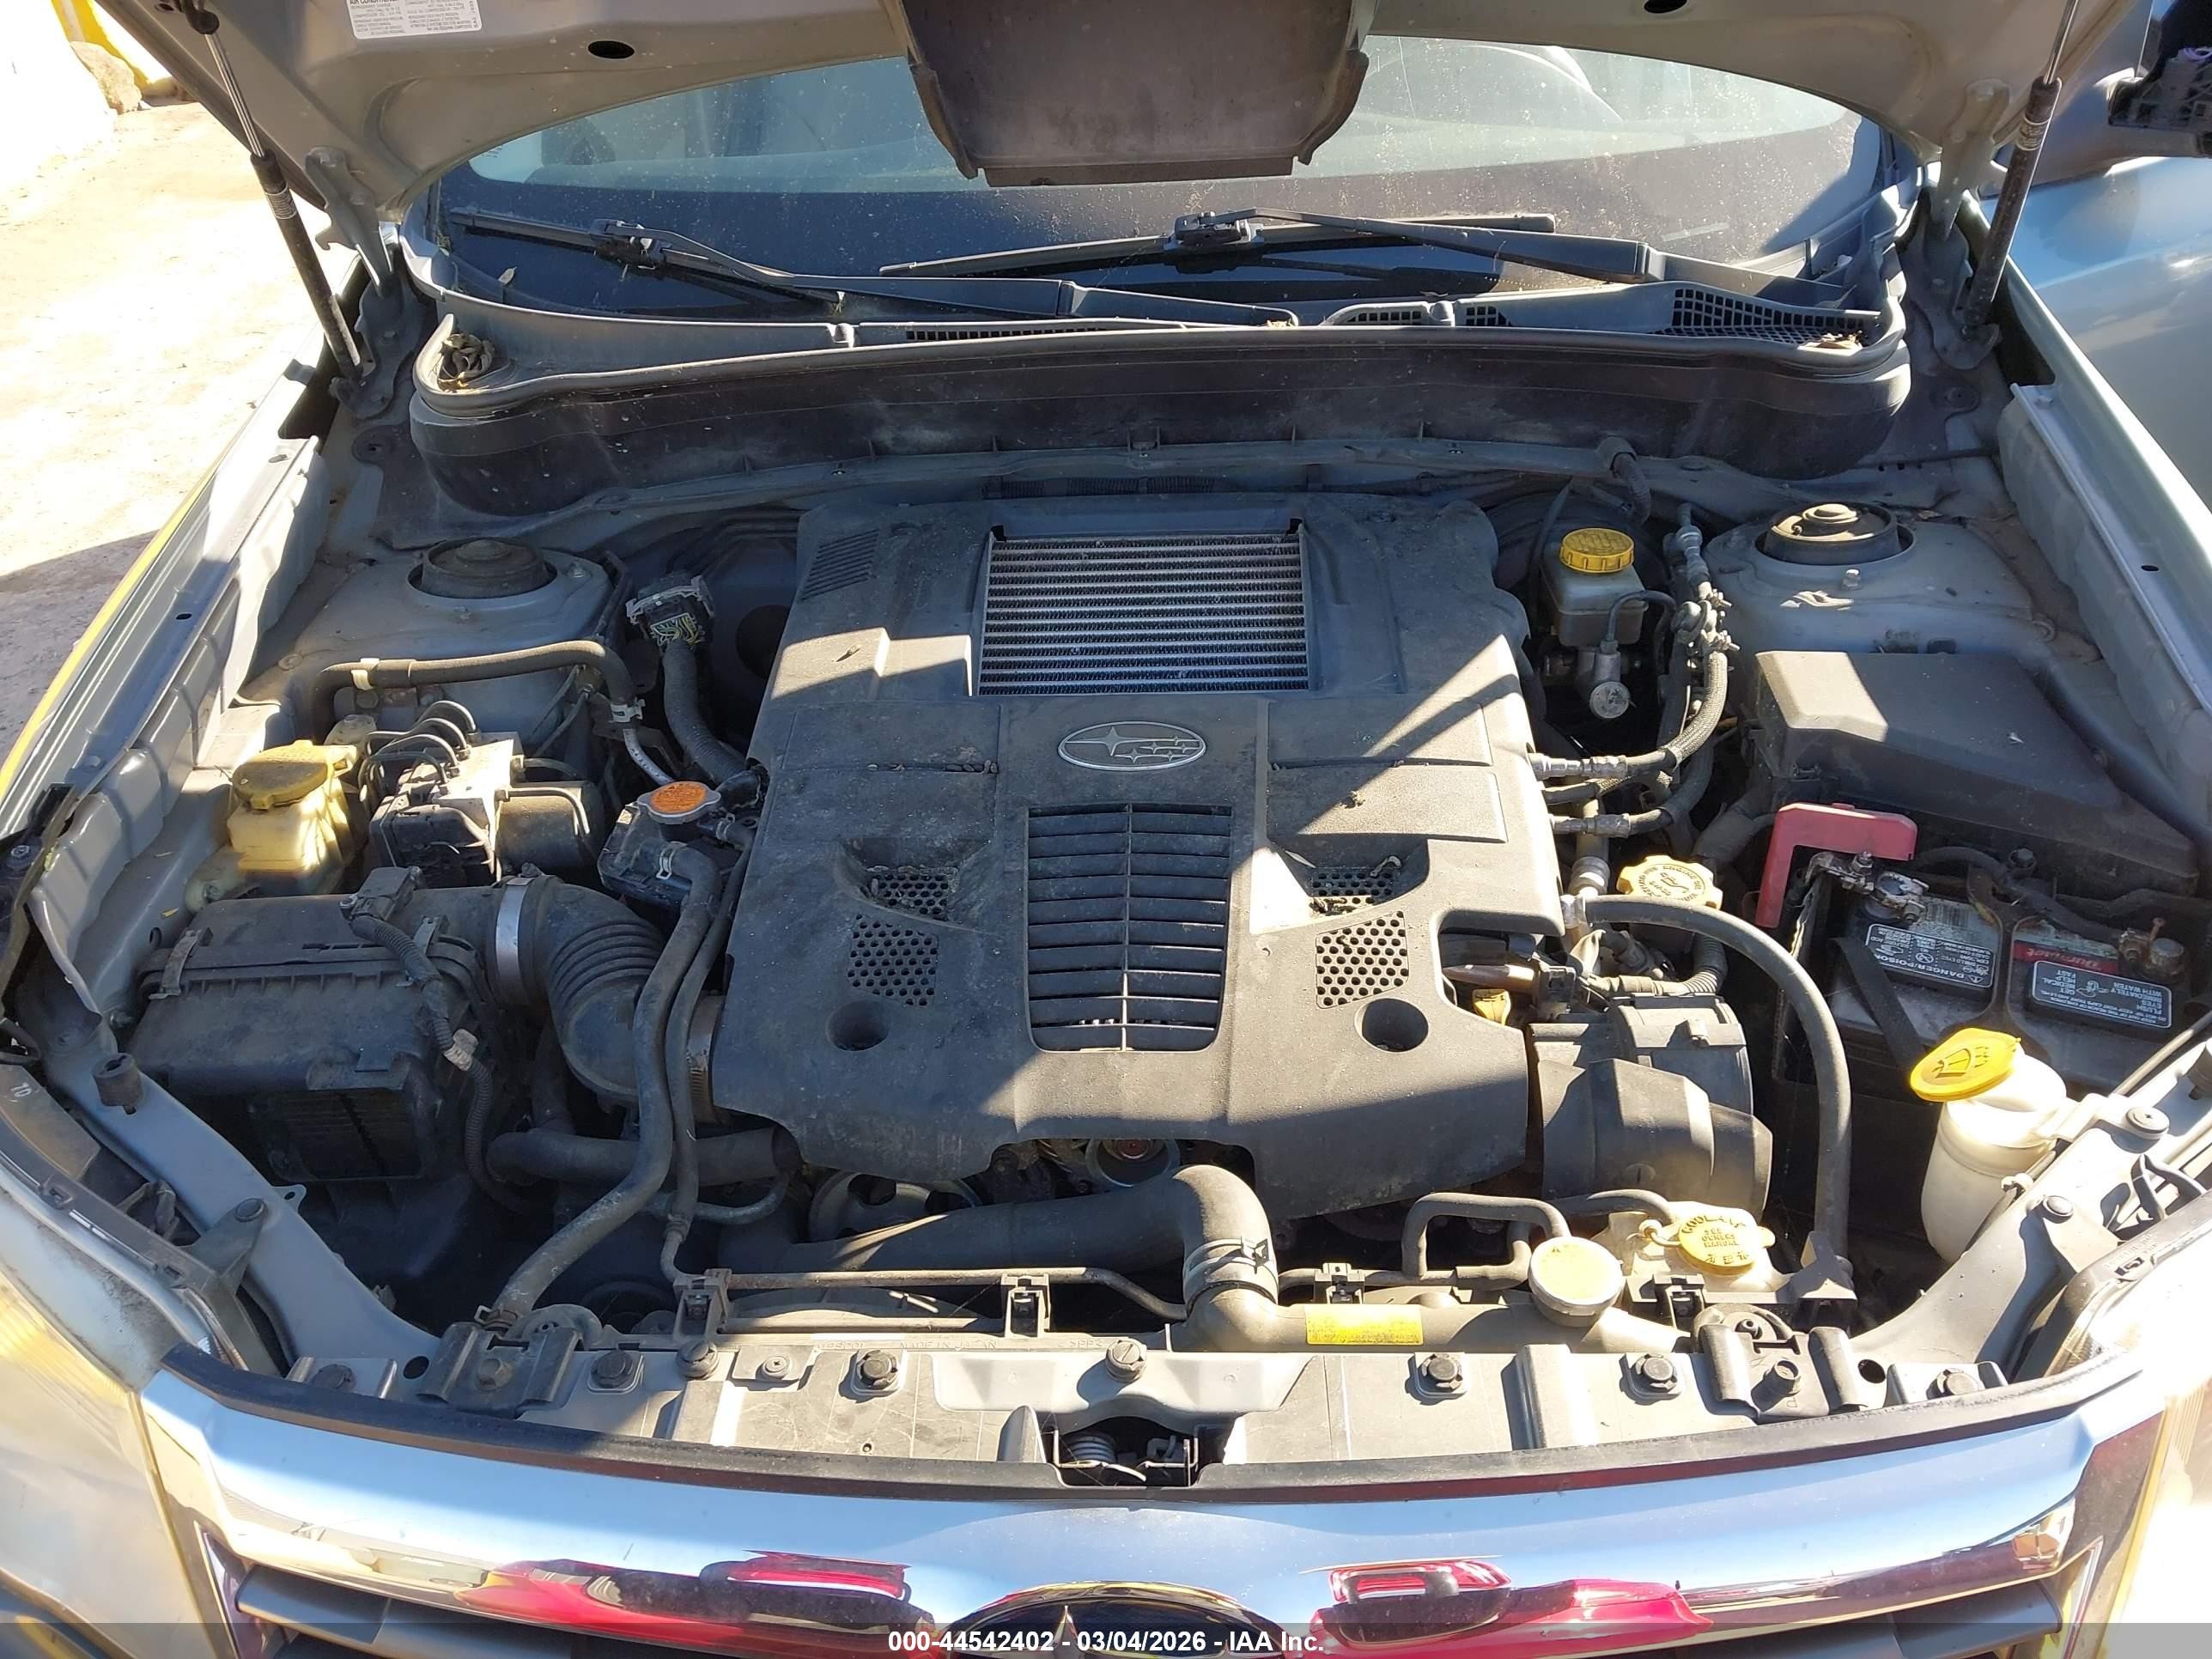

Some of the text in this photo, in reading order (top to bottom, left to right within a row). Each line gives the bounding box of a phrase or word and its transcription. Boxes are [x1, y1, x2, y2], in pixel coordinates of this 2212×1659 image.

[2056, 969, 2075, 979] FAST
[2041, 977, 2075, 989] MEDICAL
[2055, 975, 2075, 984] HELP
[2113, 981, 2163, 998] WITH WATER
[2110, 988, 2162, 1003] IMMEDIATELY
[2136, 1005, 2162, 1015] FLUSH
[2142, 1000, 2162, 1010] EYES
